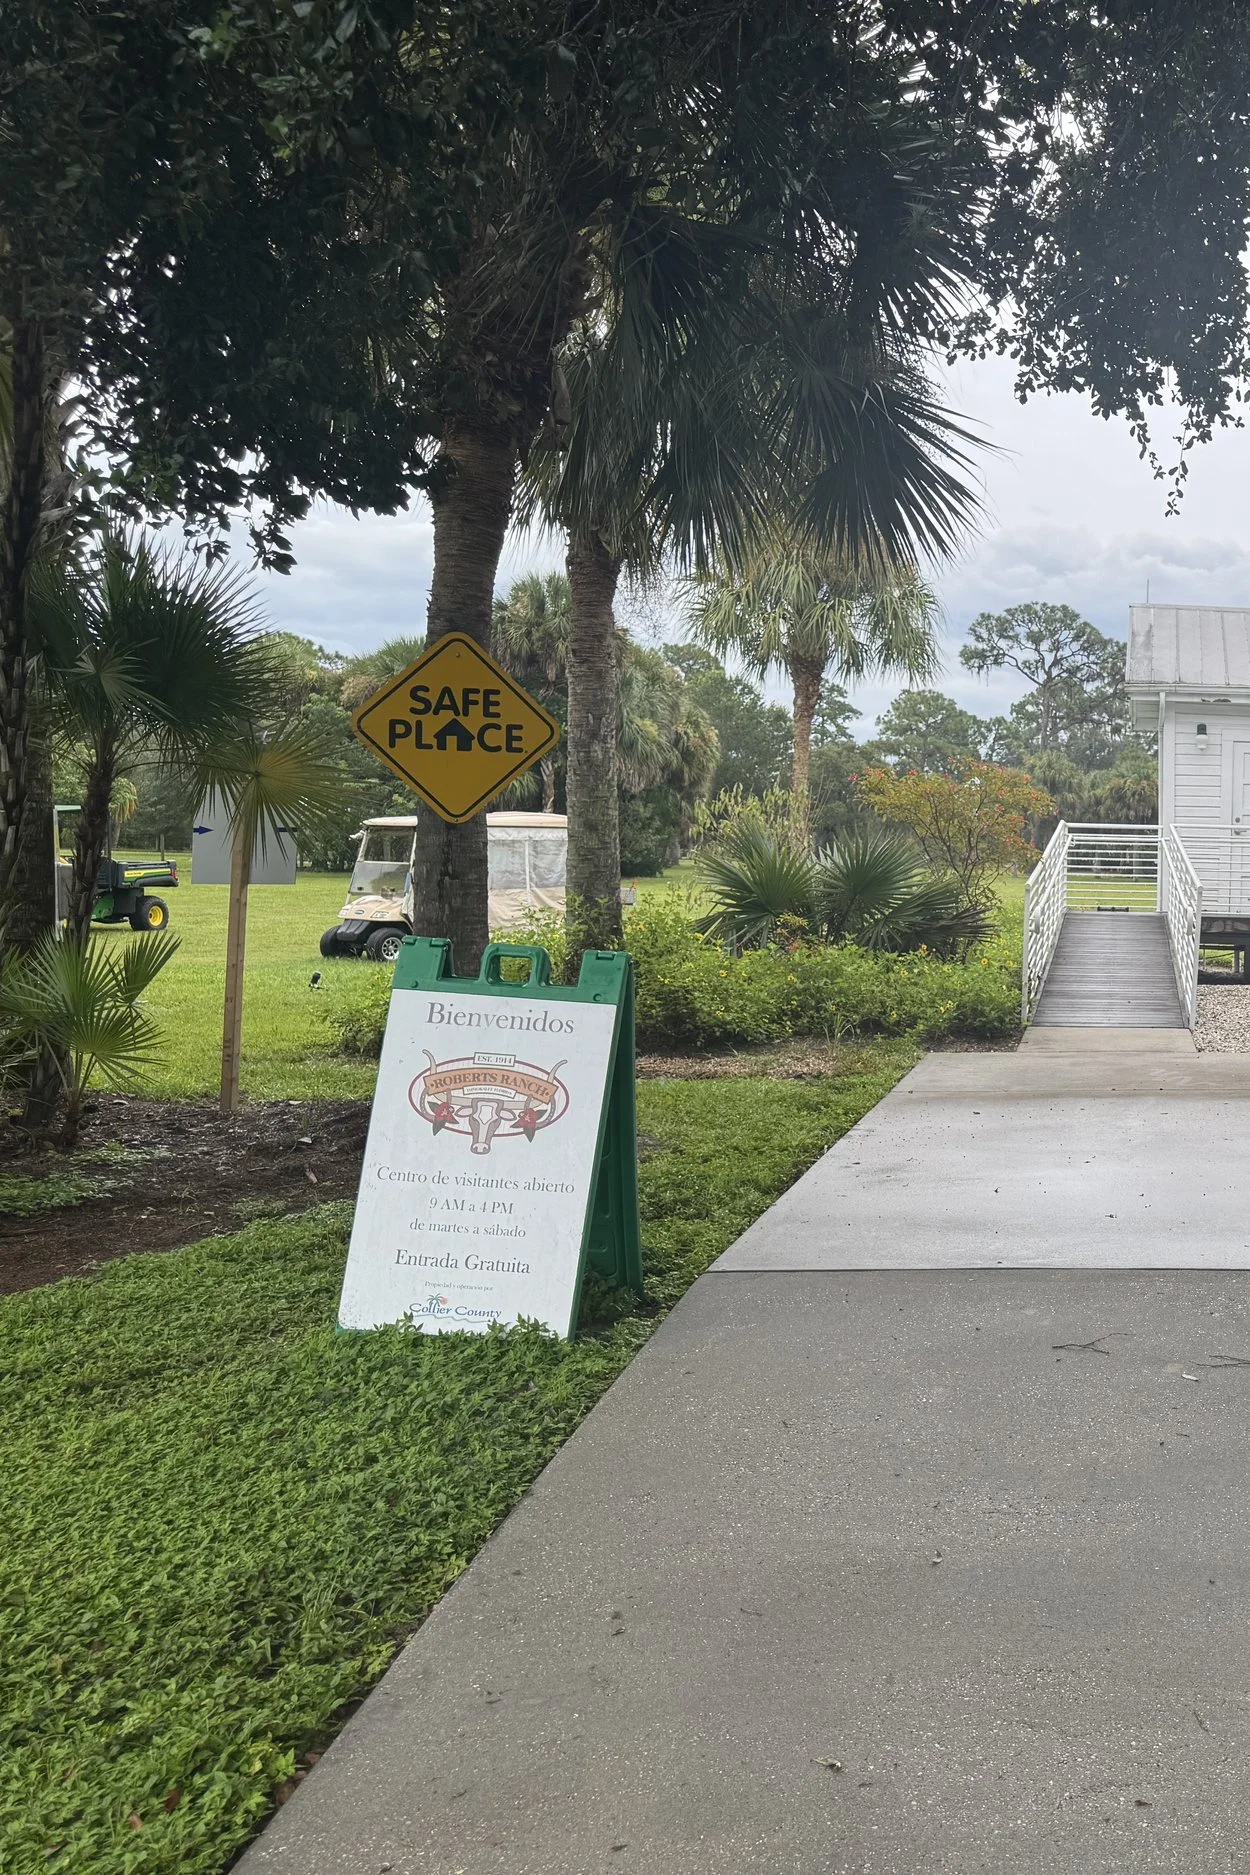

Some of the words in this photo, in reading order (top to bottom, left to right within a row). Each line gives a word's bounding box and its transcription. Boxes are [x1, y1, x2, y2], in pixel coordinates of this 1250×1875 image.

[409, 685, 501, 718] SAFE
[425, 1002, 574, 1034] Bienvenidos
[477, 1055, 493, 1063] EST.
[495, 1056, 512, 1064] 1914
[433, 1072, 498, 1089] ROBERTS
[501, 1074, 546, 1097] RANCH
[377, 1165, 427, 1184] Centro
[432, 1170, 450, 1185] de
[454, 1172, 519, 1190] visitantes
[523, 1177, 575, 1194] abierto
[429, 1197, 438, 1209] 9
[440, 1198, 465, 1211] AM
[468, 1203, 475, 1212] a
[479, 1201, 487, 1213] 4
[491, 1201, 514, 1215] PM
[410, 1218, 425, 1231] de
[428, 1221, 469, 1234] martes
[473, 1226, 480, 1235] a
[483, 1224, 526, 1238] sábado
[394, 1249, 459, 1269] Entrada
[464, 1253, 530, 1274] Gratuita
[409, 1302, 452, 1314] Collier
[454, 1306, 502, 1318] County
